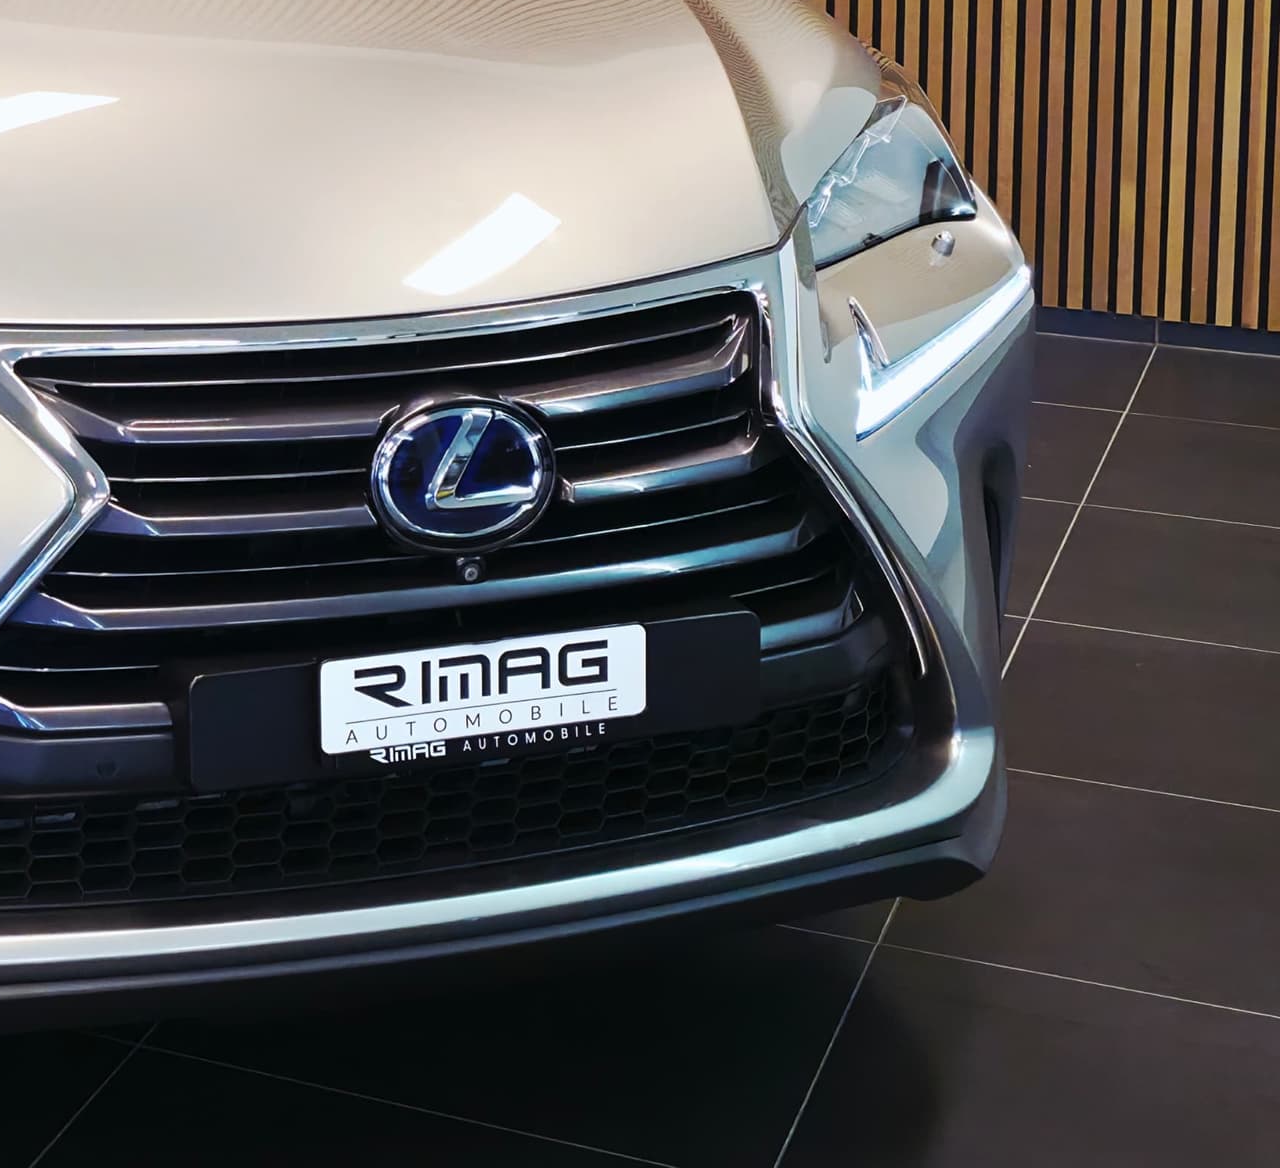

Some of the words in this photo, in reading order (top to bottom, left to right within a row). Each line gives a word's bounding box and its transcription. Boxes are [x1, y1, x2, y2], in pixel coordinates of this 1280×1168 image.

[353, 639, 609, 708] RIMAG
[345, 696, 619, 745] AUTOMOBILE
[369, 741, 447, 764] RIMAG
[462, 722, 607, 752] AUTOMOBILE
